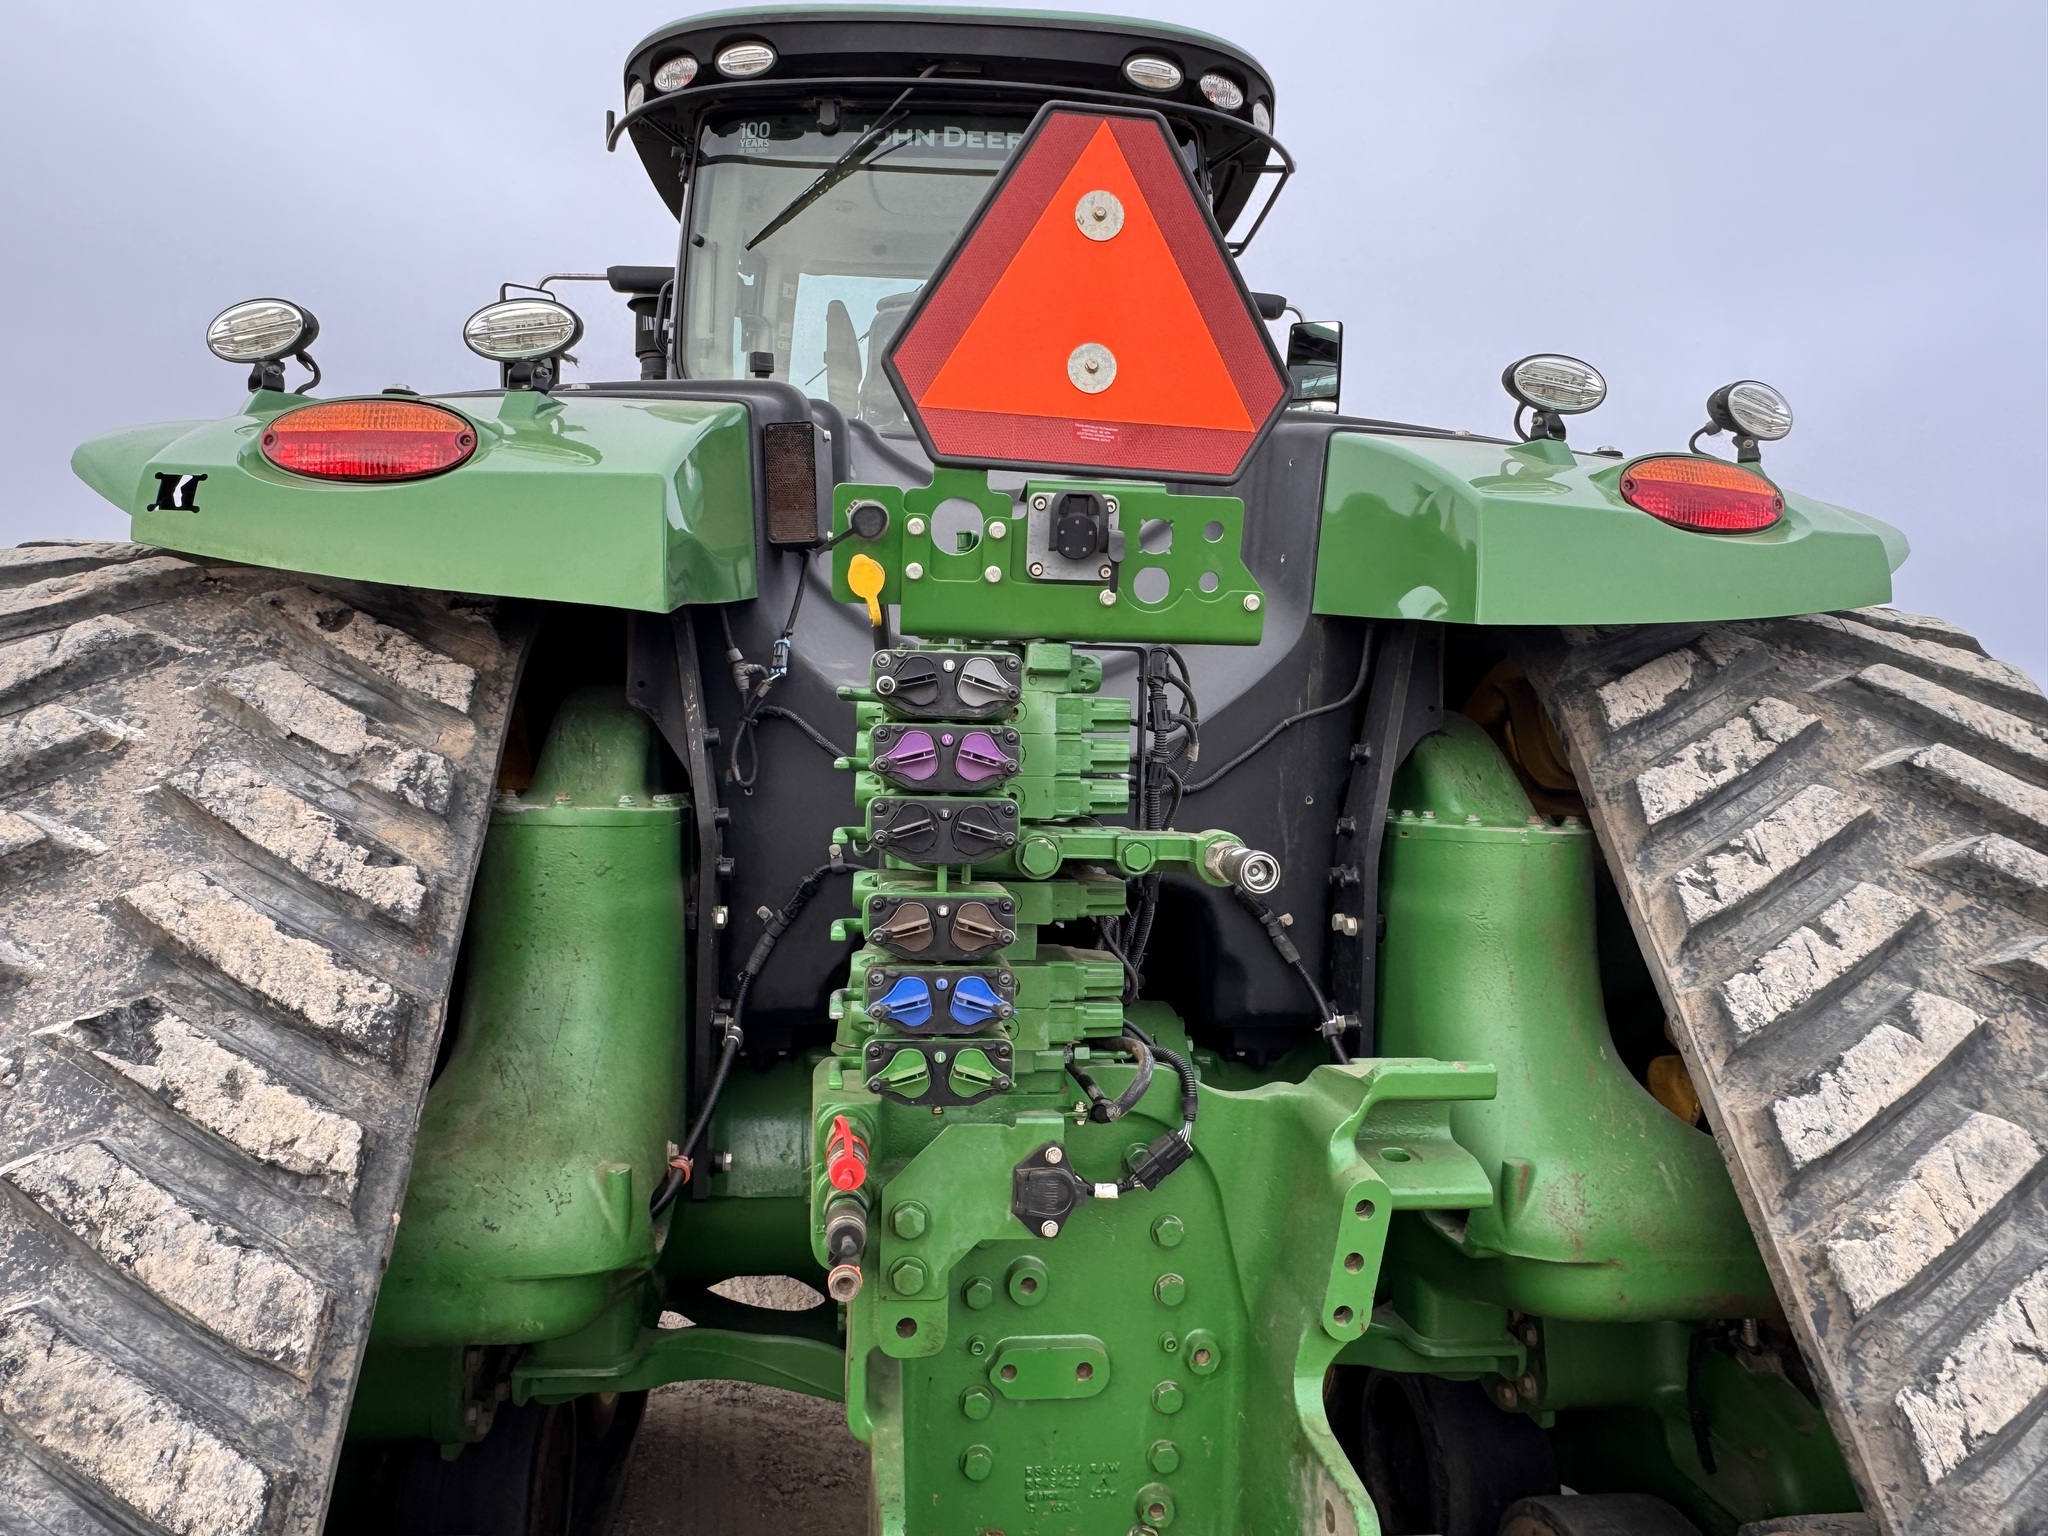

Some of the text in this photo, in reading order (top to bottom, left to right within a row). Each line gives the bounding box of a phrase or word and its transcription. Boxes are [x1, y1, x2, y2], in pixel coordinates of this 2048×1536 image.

[740, 121, 770, 138] 100
[943, 126, 1024, 150] DEER
[740, 138, 770, 148] YEARS
